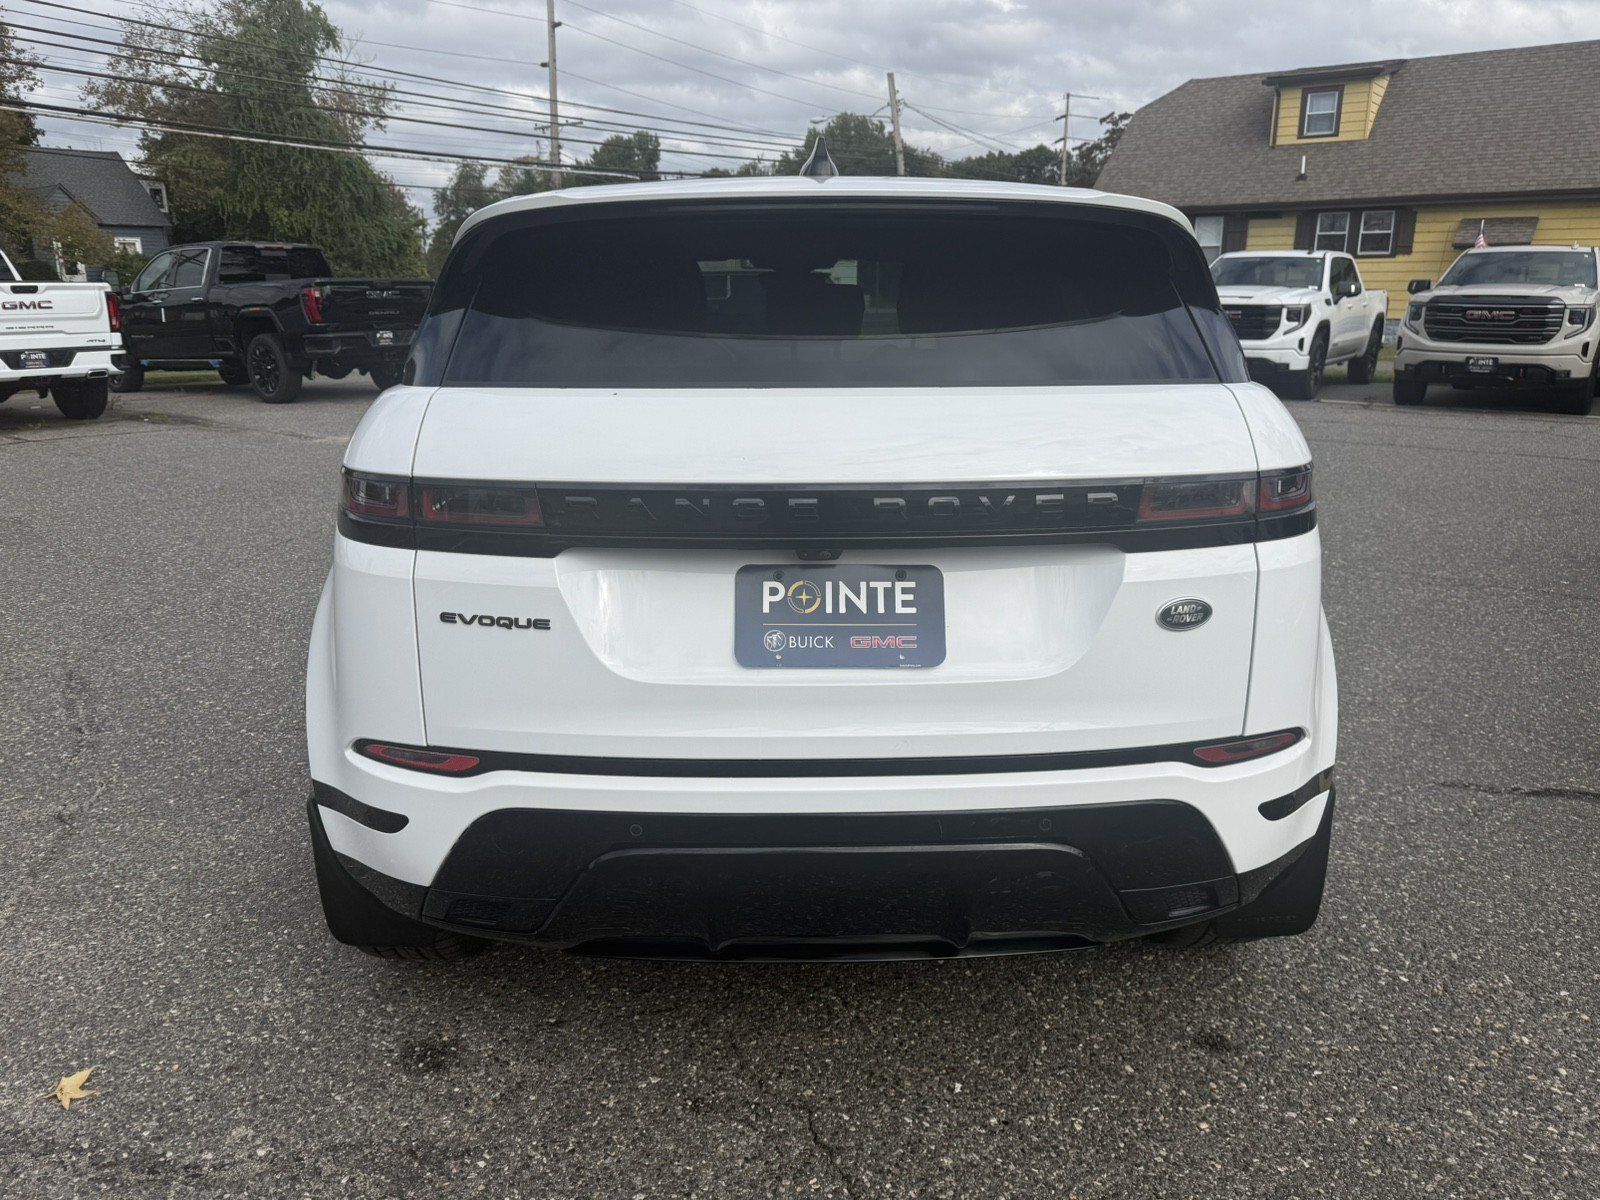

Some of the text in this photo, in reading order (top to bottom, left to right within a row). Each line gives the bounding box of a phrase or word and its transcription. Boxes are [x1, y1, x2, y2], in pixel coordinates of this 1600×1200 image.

[2, 300, 53, 310] GMC
[1465, 309, 1516, 320] GMC
[564, 492, 1121, 521] RANGE ROVER
[762, 580, 918, 614] POINTE
[1170, 604, 1197, 615] LAND
[440, 611, 551, 631] EVOQUE
[1171, 612, 1205, 624] ROVER
[789, 635, 918, 649] BUICK GMC
